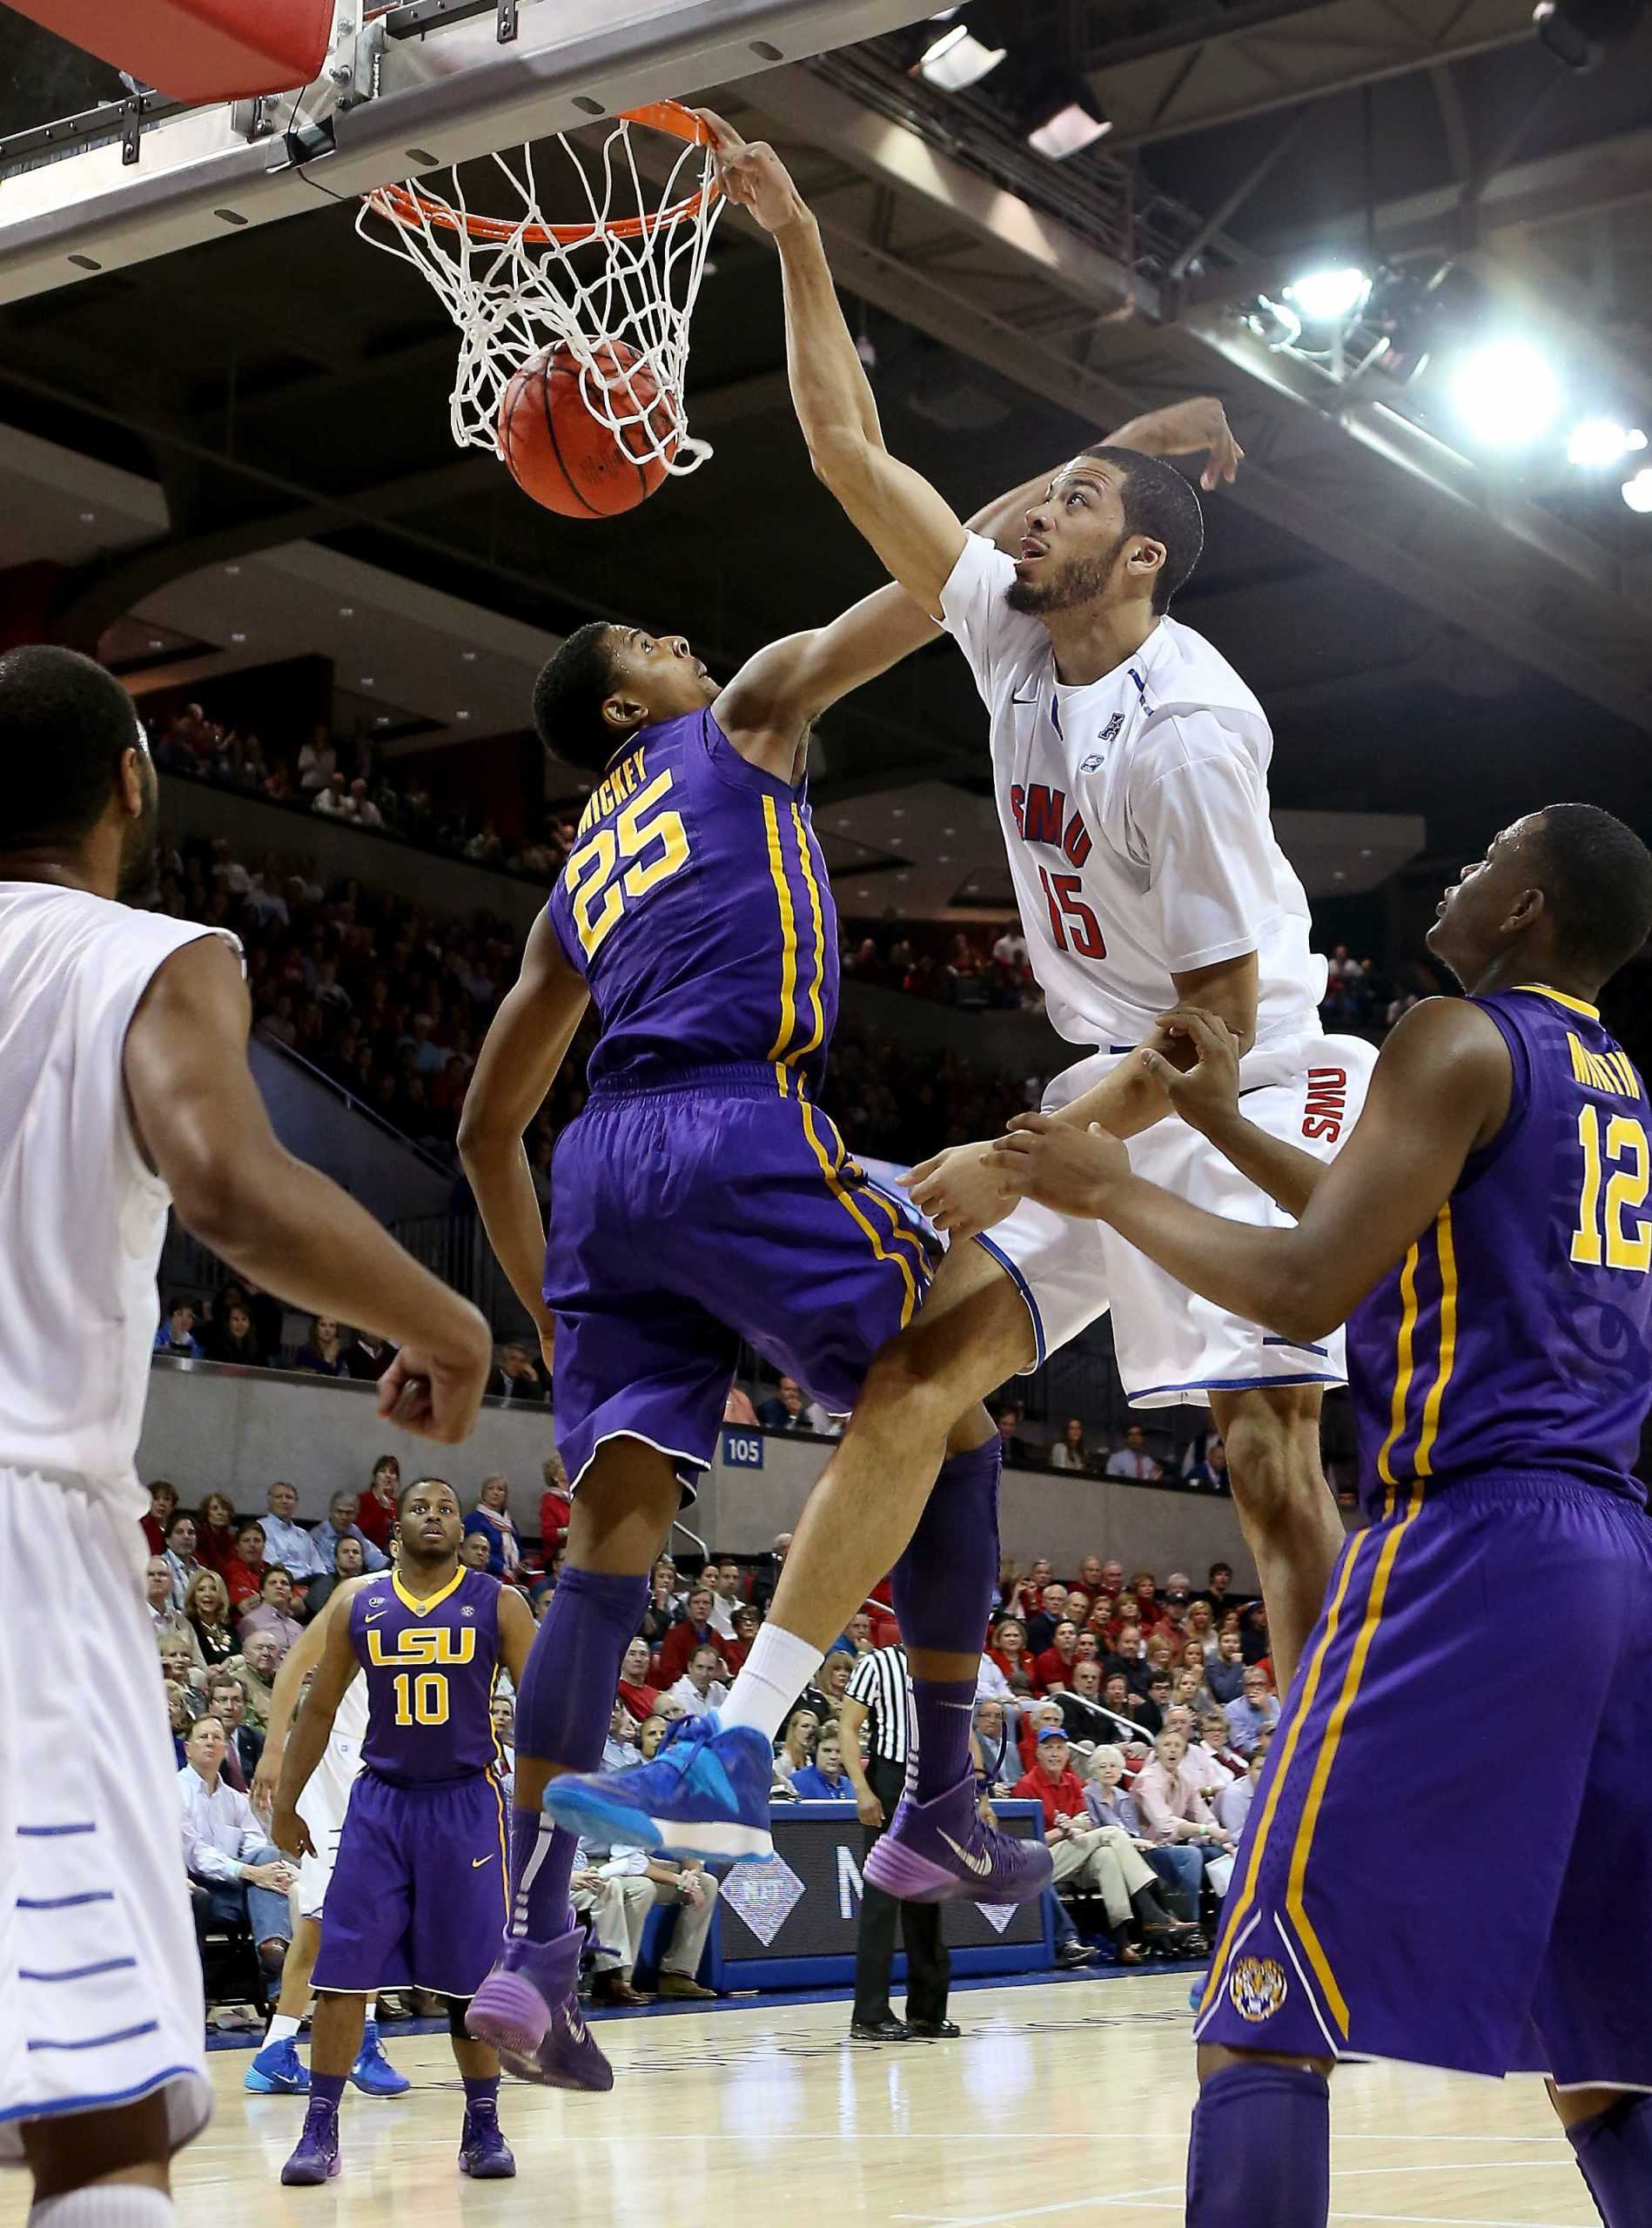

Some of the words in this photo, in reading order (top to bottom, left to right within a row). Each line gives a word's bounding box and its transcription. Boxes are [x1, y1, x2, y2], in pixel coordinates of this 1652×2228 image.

[577, 745, 648, 839] MICKEY
[565, 767, 691, 963] 25
[1038, 863, 1108, 960] 15
[1301, 1067, 1347, 1144] SMU
[1570, 1103, 1652, 1273] 12
[728, 1437, 760, 1462] 105
[366, 1627, 476, 1666] LSU
[393, 1673, 450, 1726] 10
